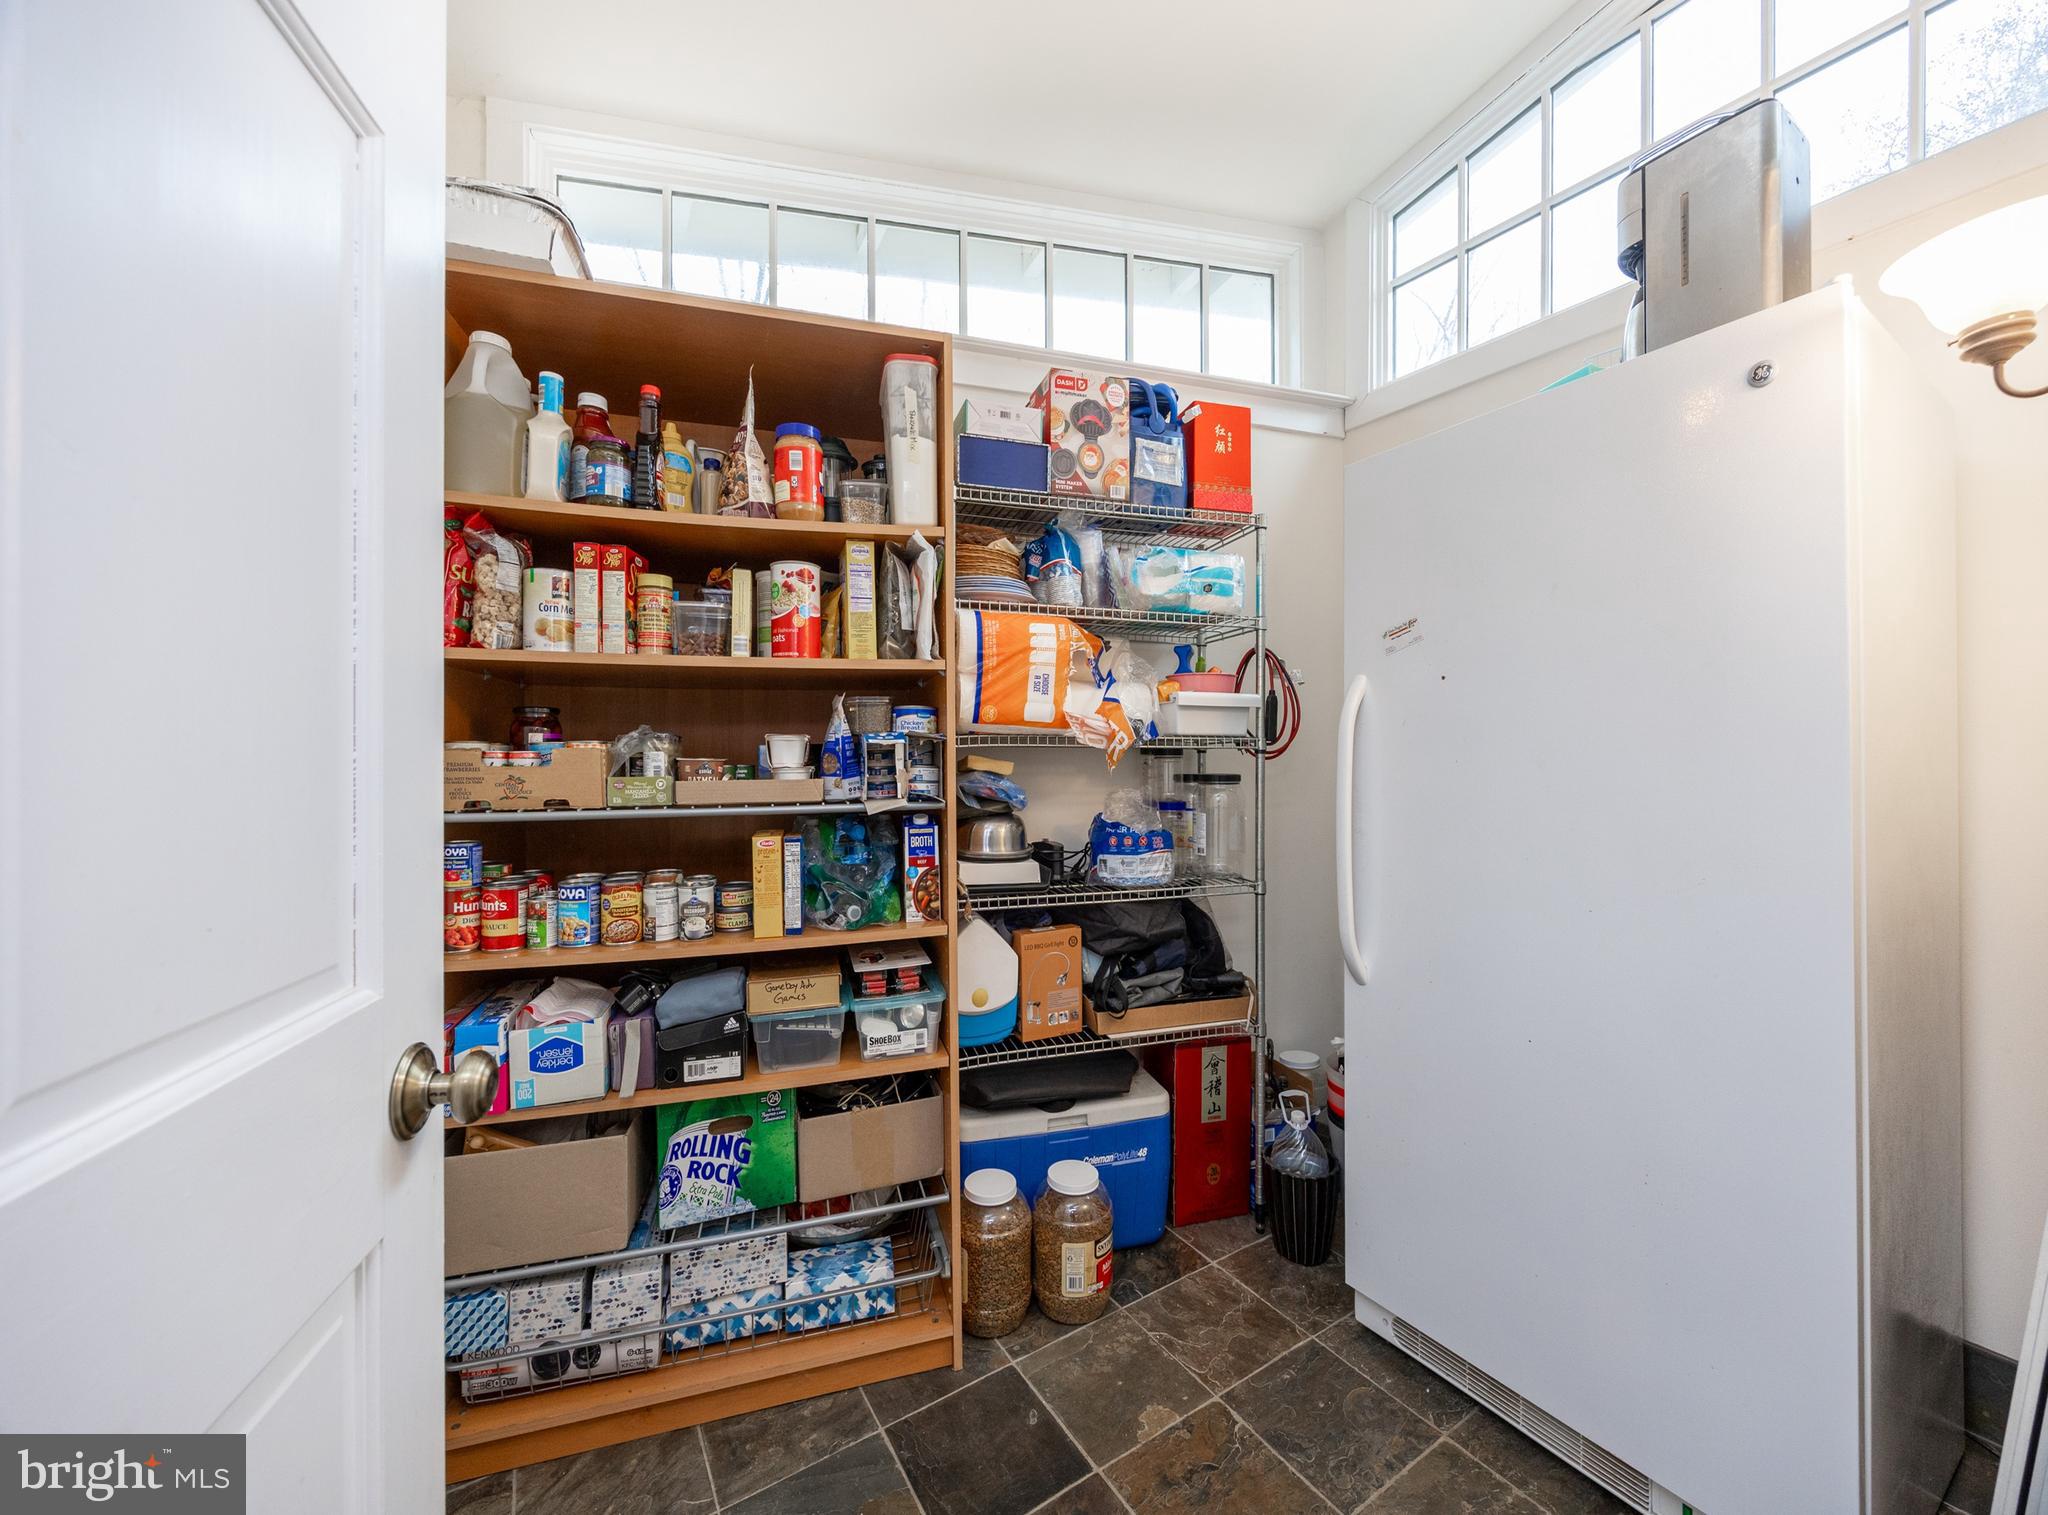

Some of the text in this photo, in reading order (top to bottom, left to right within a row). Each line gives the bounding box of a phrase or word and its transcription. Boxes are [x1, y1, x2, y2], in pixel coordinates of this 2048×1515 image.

[1056, 379, 1074, 387] DASH
[538, 602, 559, 612] Corn
[1033, 681, 1041, 693] SIZE
[1041, 673, 1050, 696] CHOOSE
[910, 835, 933, 848] BROTH
[773, 992, 807, 1004] Games
[536, 1056, 574, 1069] berkley
[1203, 1054, 1226, 1116] 會稽山
[517, 1088, 532, 1100] 200
[769, 1093, 779, 1103] 24
[669, 1133, 752, 1165] ROLLING
[687, 1160, 744, 1190] ROCK
[689, 1181, 725, 1201] Extra Pale
[467, 1344, 521, 1360] KENWOOD
